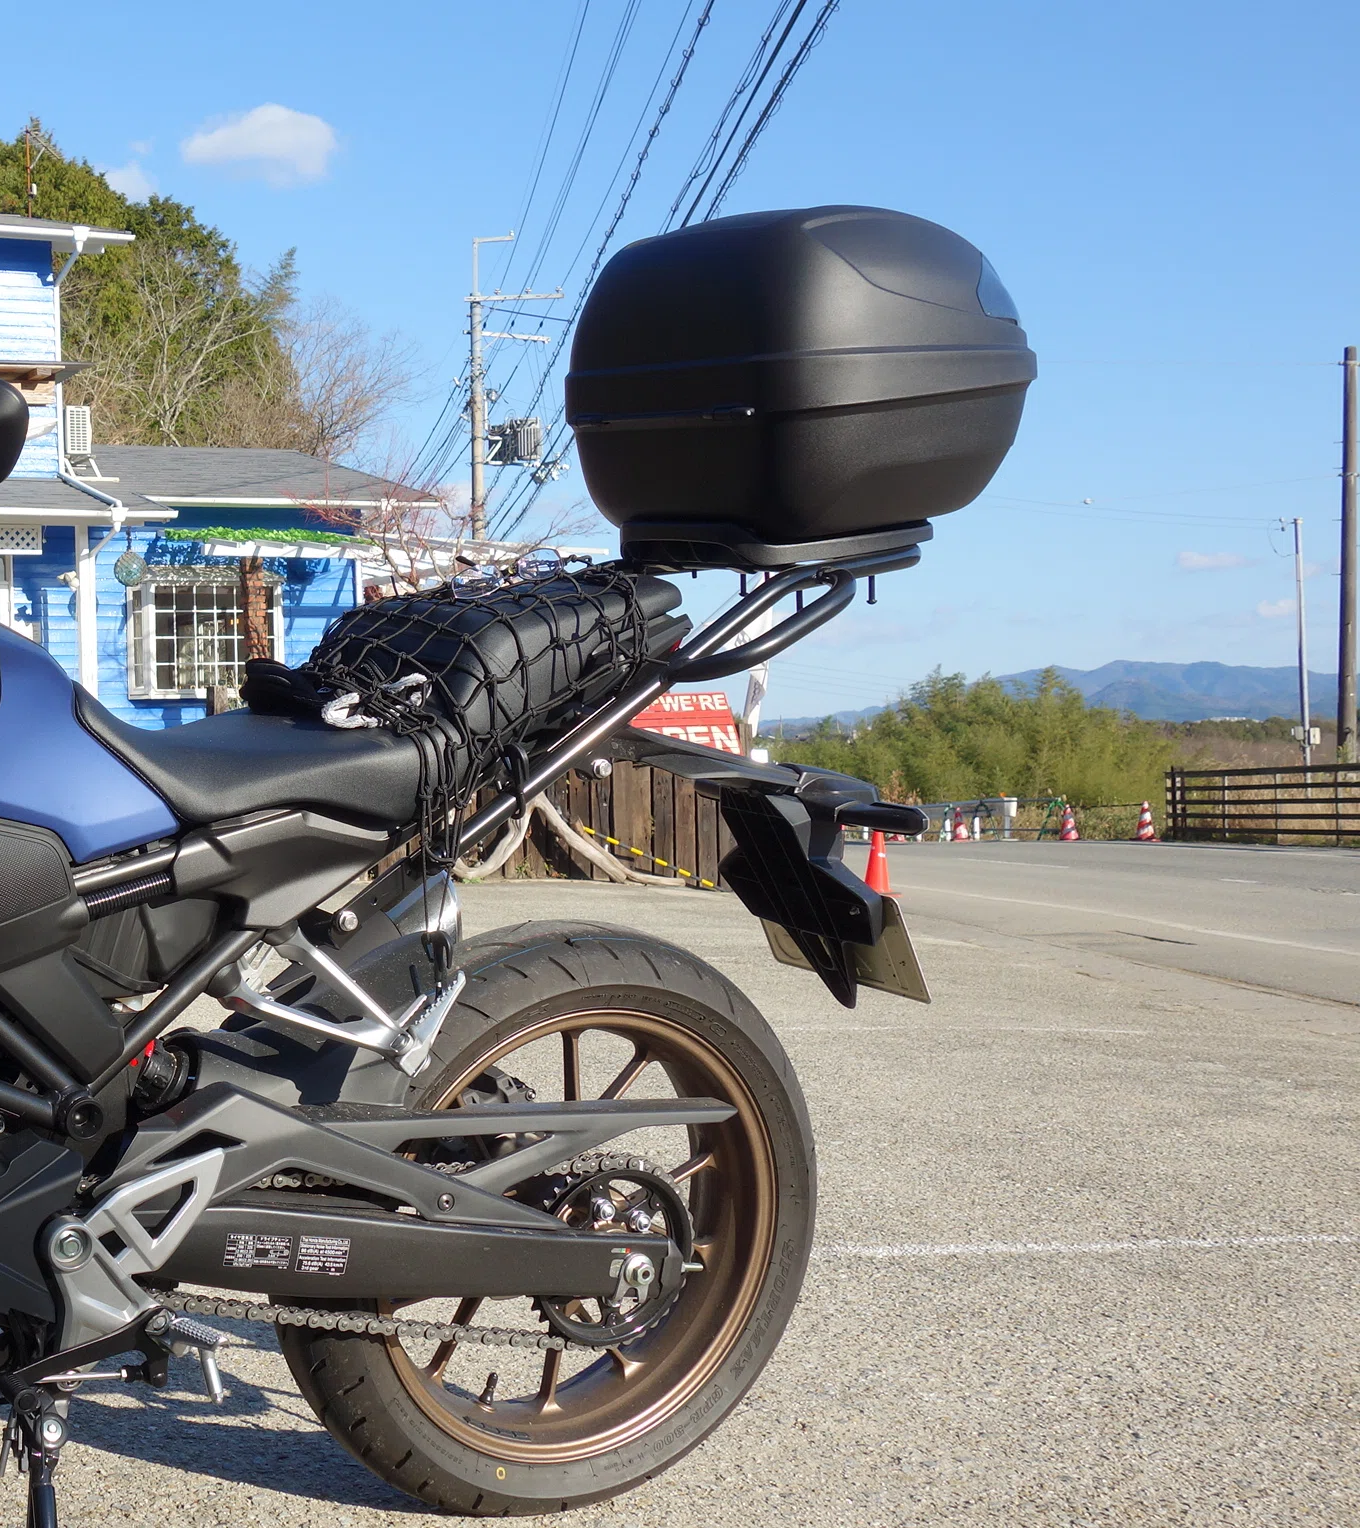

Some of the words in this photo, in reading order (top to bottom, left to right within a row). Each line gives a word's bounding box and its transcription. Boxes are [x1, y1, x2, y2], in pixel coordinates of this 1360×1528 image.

[659, 694, 729, 712] WE'RE
[643, 725, 741, 756] PEN
[730, 1240, 794, 1380] SPORTMAX
[653, 1385, 724, 1453] GPR-300
